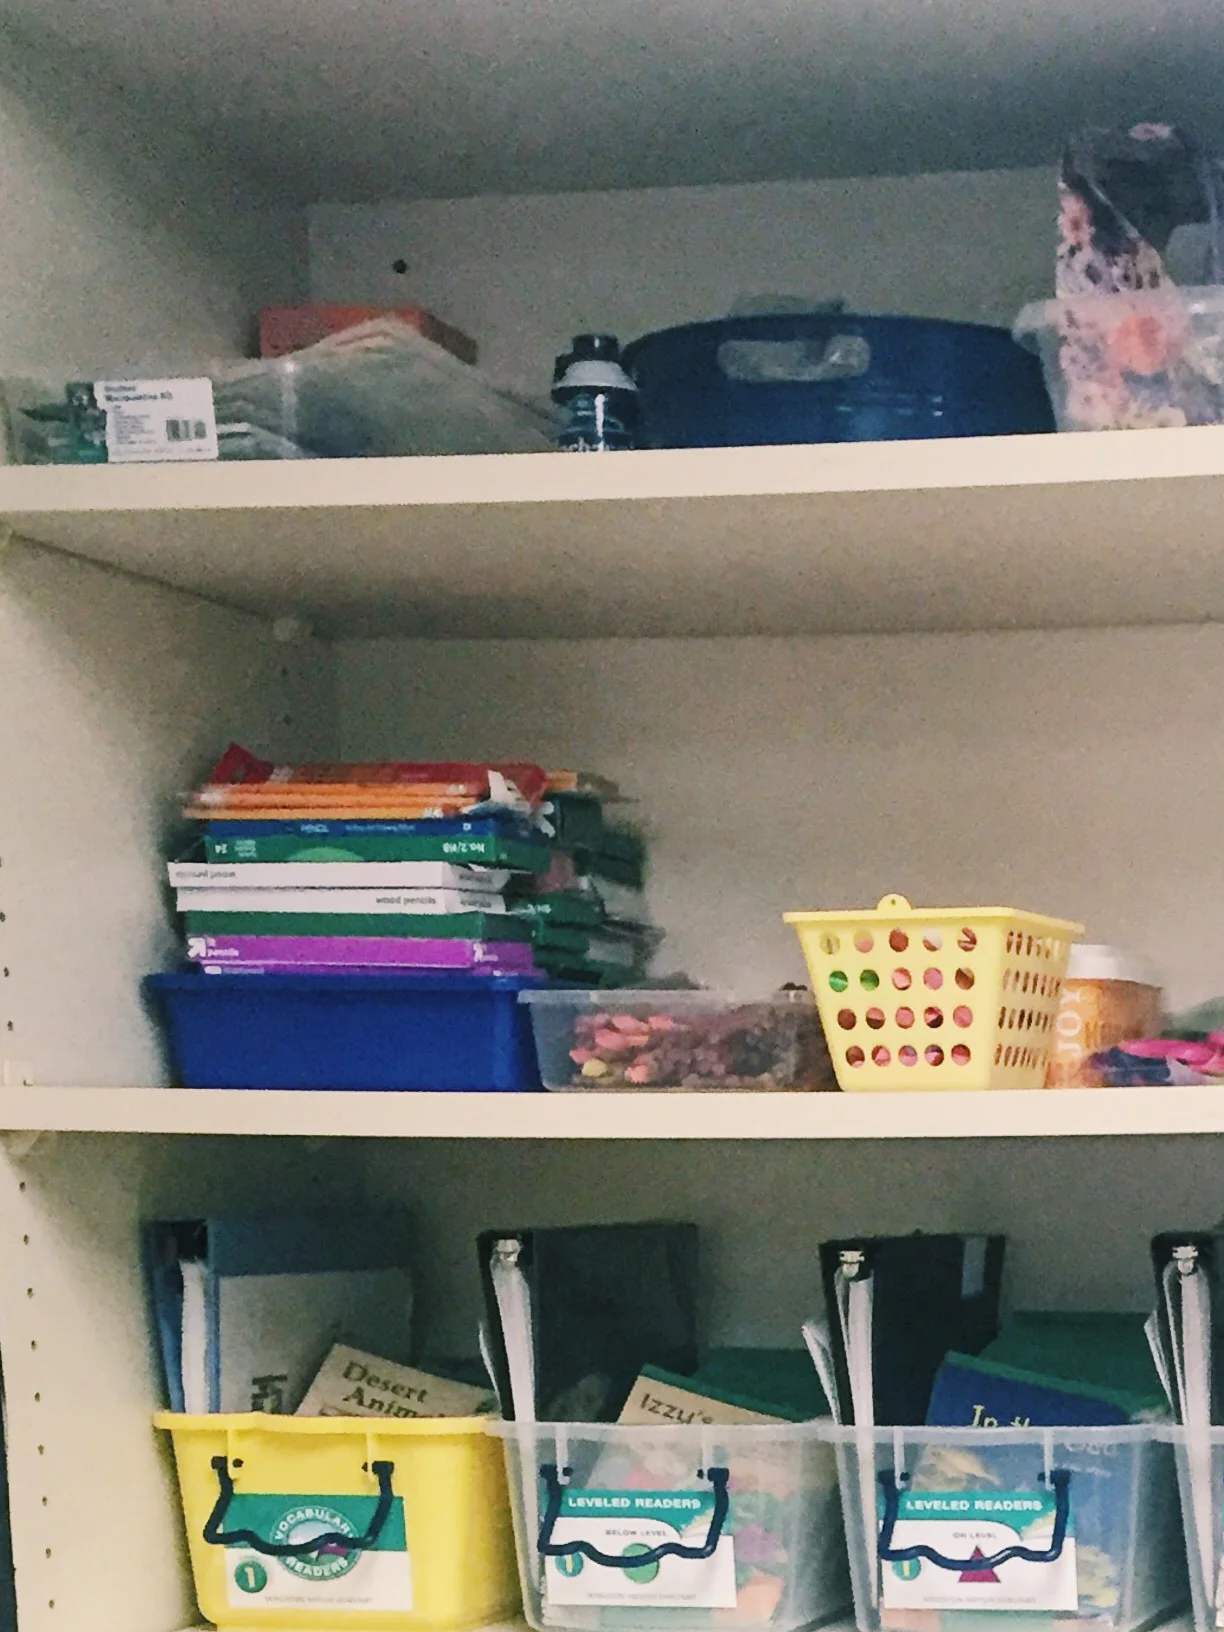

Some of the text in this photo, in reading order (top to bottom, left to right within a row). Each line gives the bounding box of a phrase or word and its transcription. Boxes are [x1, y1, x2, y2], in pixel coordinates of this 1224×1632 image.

[342, 1361, 429, 1404] Desert
[342, 1385, 424, 1419] Anim
[568, 1497, 701, 1509] LEVELED READERS
[906, 1500, 1043, 1511] LEVELED READERS
[274, 1508, 354, 1541] VOCABULAR
[285, 1556, 349, 1577] READERS
[244, 1567, 256, 1588] 1
